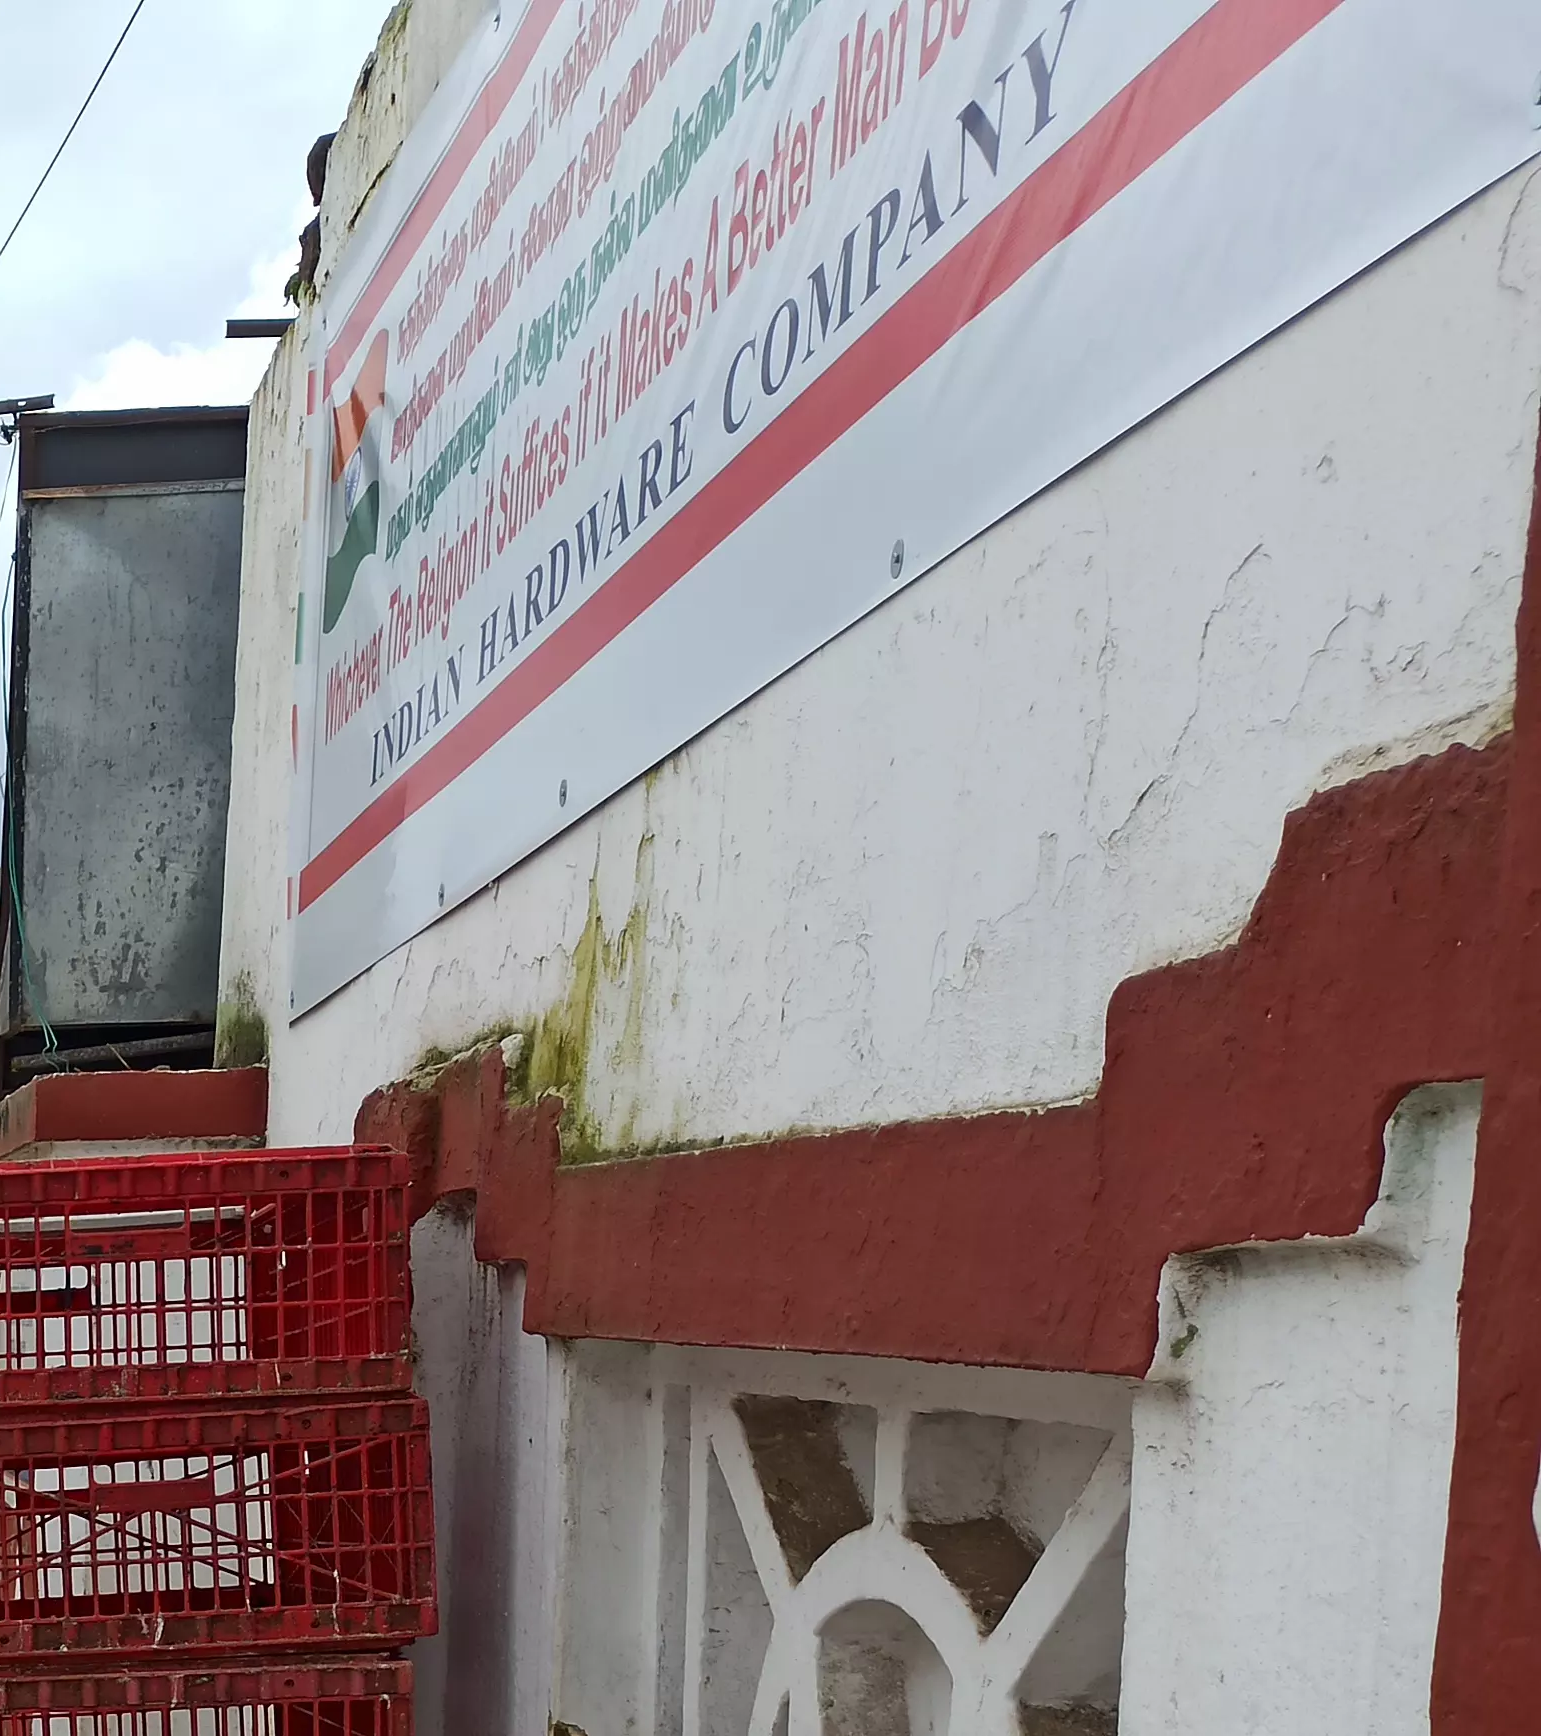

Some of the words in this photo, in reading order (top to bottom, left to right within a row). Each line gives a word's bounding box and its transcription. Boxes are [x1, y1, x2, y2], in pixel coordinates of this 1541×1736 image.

[324, 630, 386, 746] Whichever
[387, 584, 411, 677] The
[413, 516, 480, 648] Religion
[480, 483, 494, 572] it
[496, 404, 572, 556] Suffices
[575, 345, 596, 468] if
[595, 330, 613, 446] it
[616, 256, 694, 424] Makes
[696, 194, 721, 331] A
[726, 95, 826, 298] Better
[829, 0, 909, 180] Man
[369, 641, 466, 787] INDIAN
[475, 399, 696, 687] HARDWARE
[721, 0, 1076, 435] COMPANY
[557, 258, 587, 363] ஒரு
